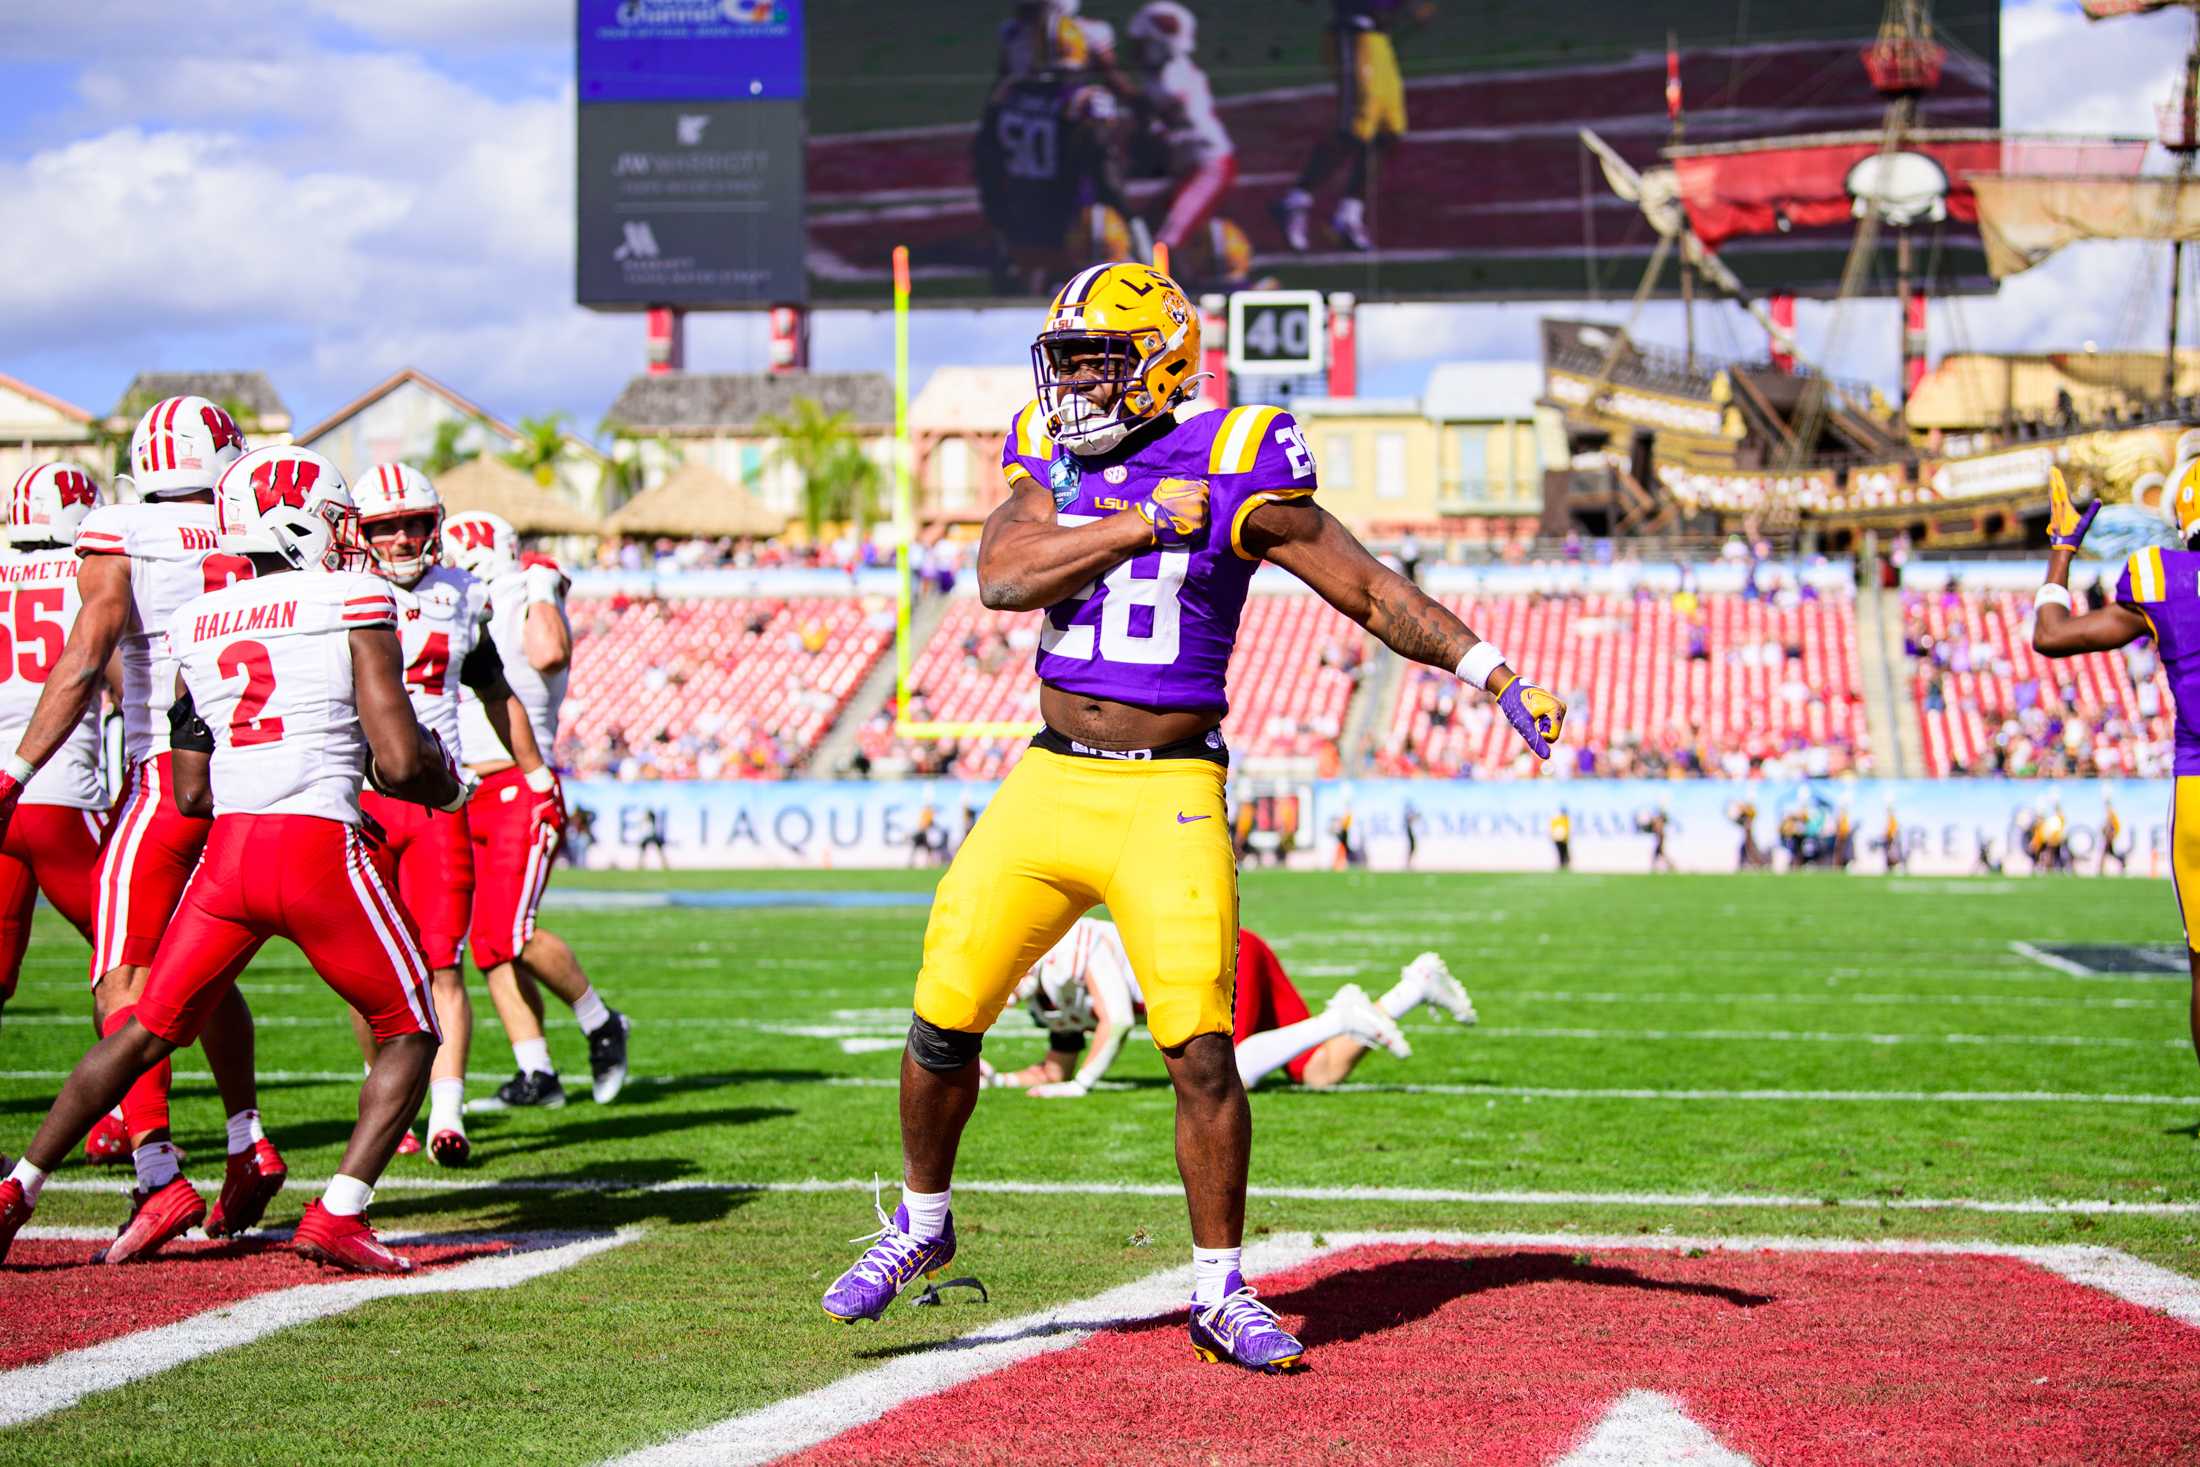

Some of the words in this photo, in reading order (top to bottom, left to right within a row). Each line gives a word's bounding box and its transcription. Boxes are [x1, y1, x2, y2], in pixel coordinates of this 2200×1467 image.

[1052, 318, 1074, 330] LSU
[1246, 308, 1309, 356] 40
[53, 470, 98, 509] W
[250, 459, 321, 518] W
[1094, 496, 1129, 511] LSU
[447, 520, 496, 551] W
[0, 588, 65, 684] 5
[193, 600, 298, 643] HALLMAN
[217, 640, 285, 748] 2
